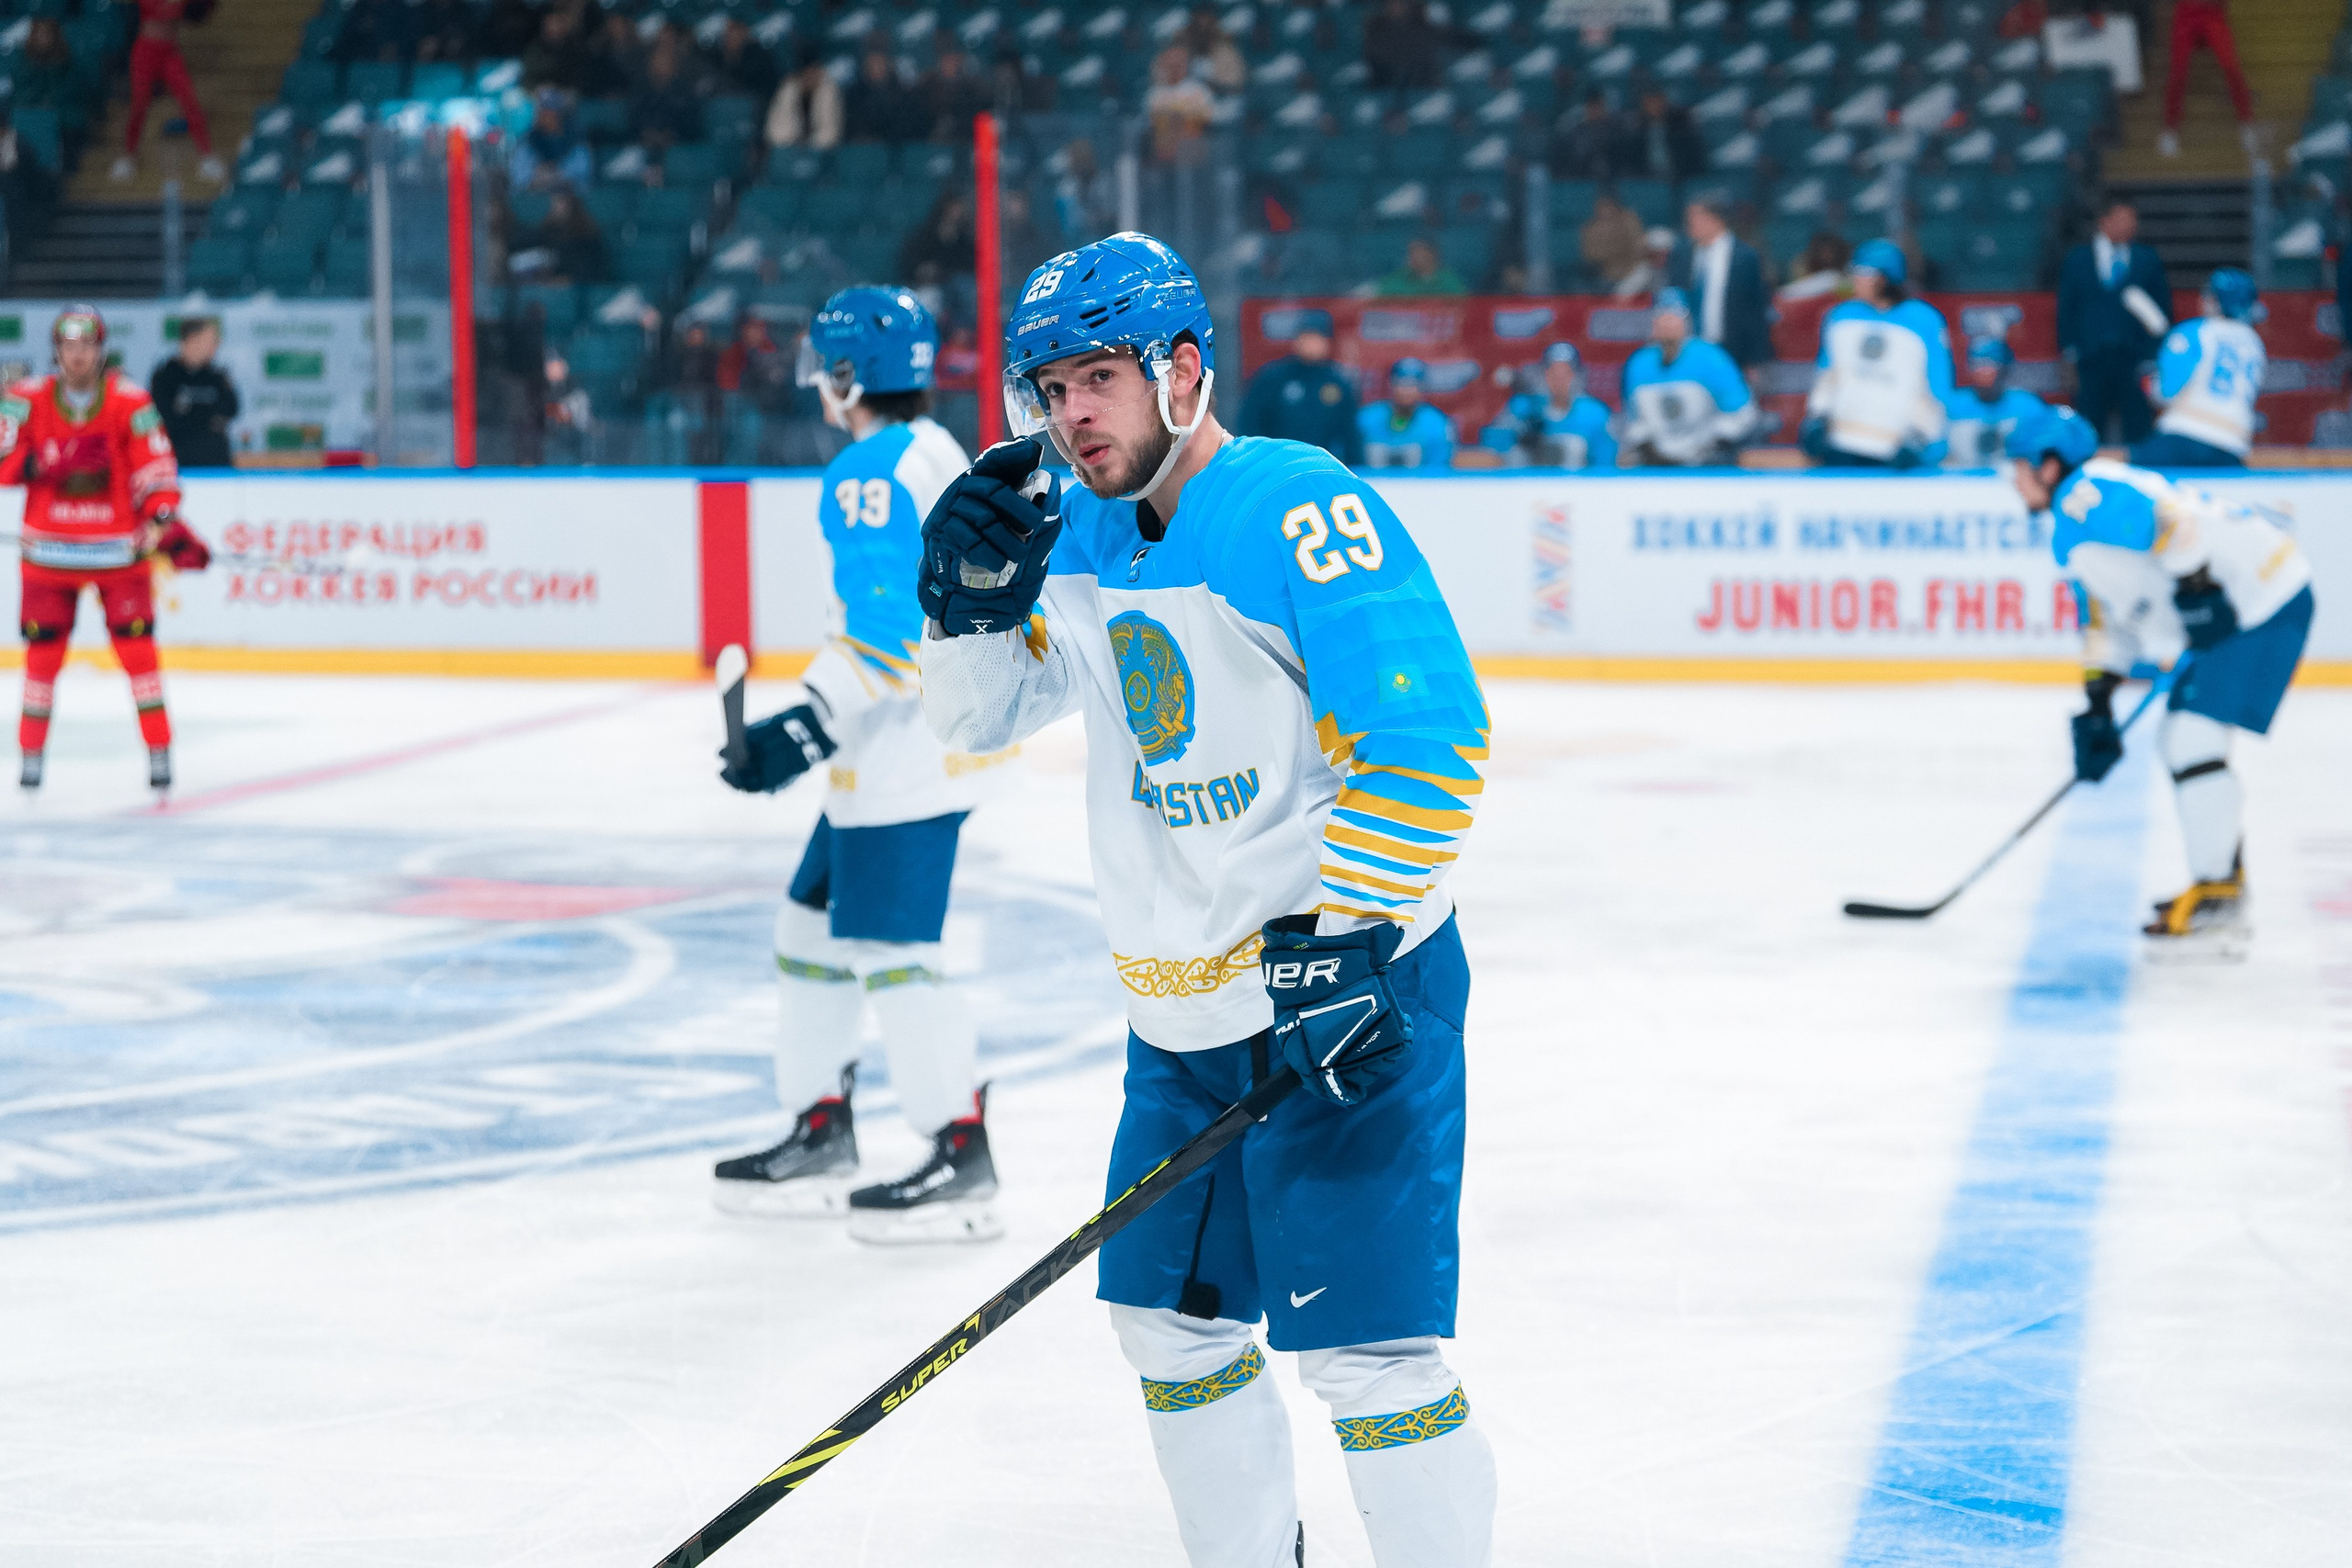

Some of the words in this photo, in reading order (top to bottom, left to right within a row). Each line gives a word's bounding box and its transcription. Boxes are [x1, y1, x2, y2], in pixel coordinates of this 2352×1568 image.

[1022, 270, 1065, 305] 29
[1017, 314, 1060, 336] BAUER
[223, 521, 487, 558] ФЕДЕРАЦИЯ
[1281, 493, 1384, 584] 29
[228, 570, 398, 604] ХОККЕЯ
[413, 570, 598, 604] РОССИИ
[1696, 579, 2080, 631] JUNIOR.FHR.R
[880, 1337, 968, 1414] SUPER
[974, 1225, 1103, 1341] TACKS
